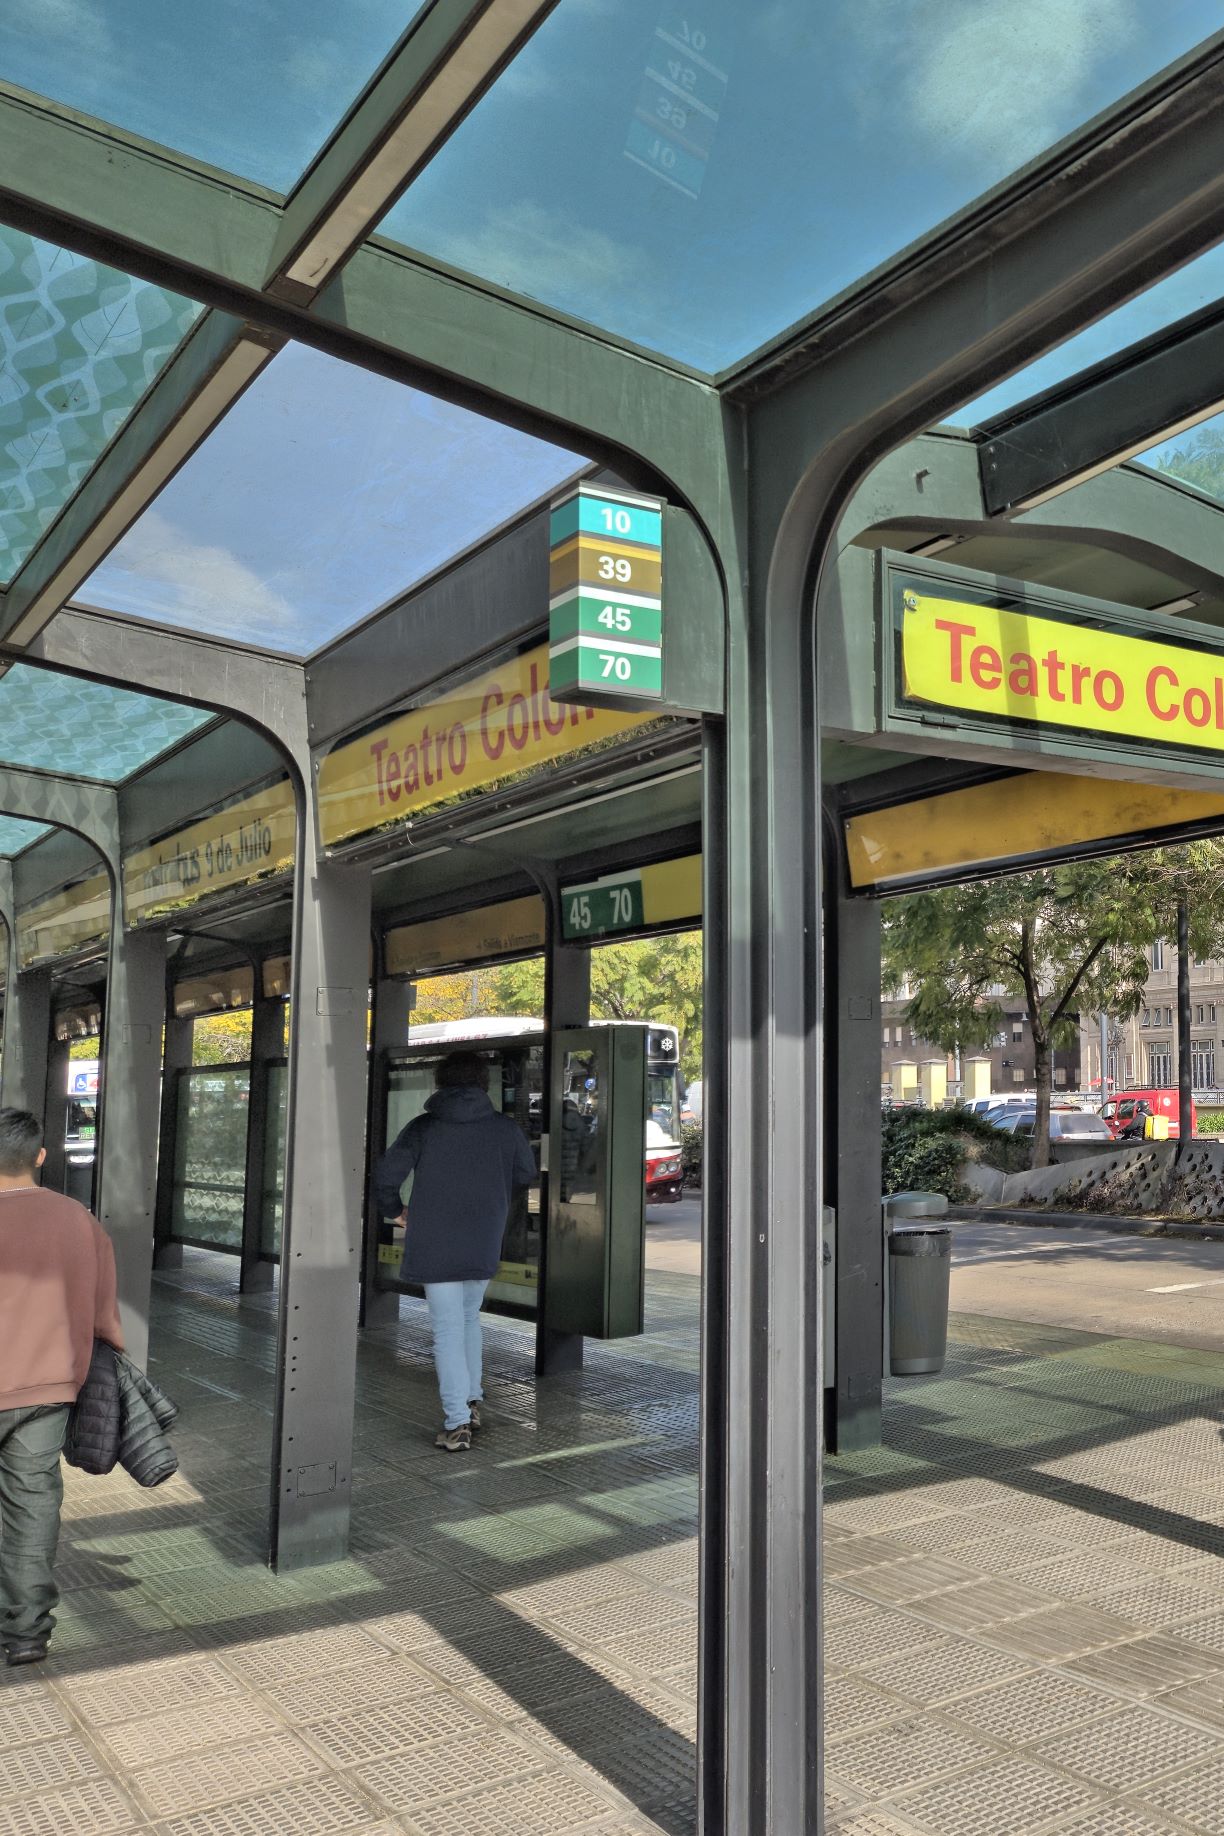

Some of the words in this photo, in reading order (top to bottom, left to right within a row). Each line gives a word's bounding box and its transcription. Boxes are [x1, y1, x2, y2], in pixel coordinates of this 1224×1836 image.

[600, 507, 631, 533] 10
[598, 555, 632, 583] 39
[597, 605, 632, 631] 45
[598, 654, 632, 680] 70
[935, 619, 1125, 711] Teatro
[370, 720, 467, 806] Teatro
[217, 834, 233, 873] de
[236, 818, 271, 866] Julio
[569, 896, 592, 930] 45
[609, 888, 632, 924] 70
